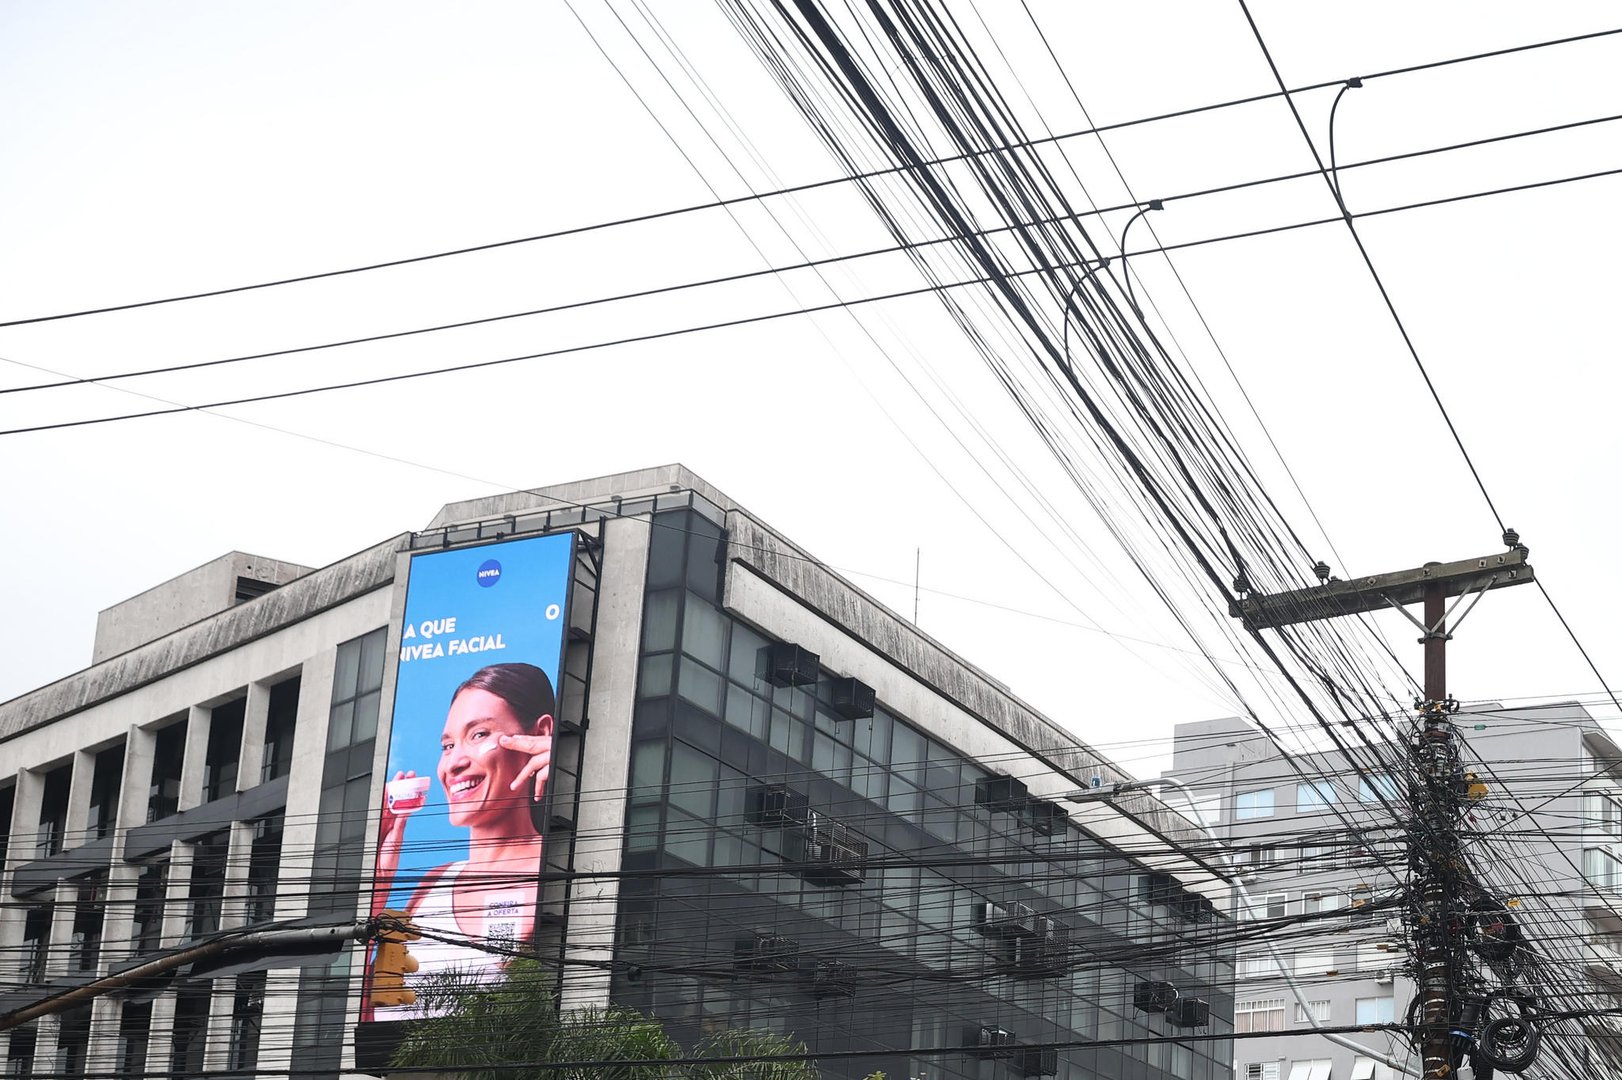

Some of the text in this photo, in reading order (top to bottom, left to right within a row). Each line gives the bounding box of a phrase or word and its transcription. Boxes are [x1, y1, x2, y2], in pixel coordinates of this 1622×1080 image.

[478, 568, 500, 578] NIVEA
[403, 617, 456, 639] A QUE
[448, 634, 505, 655] FACIAL
